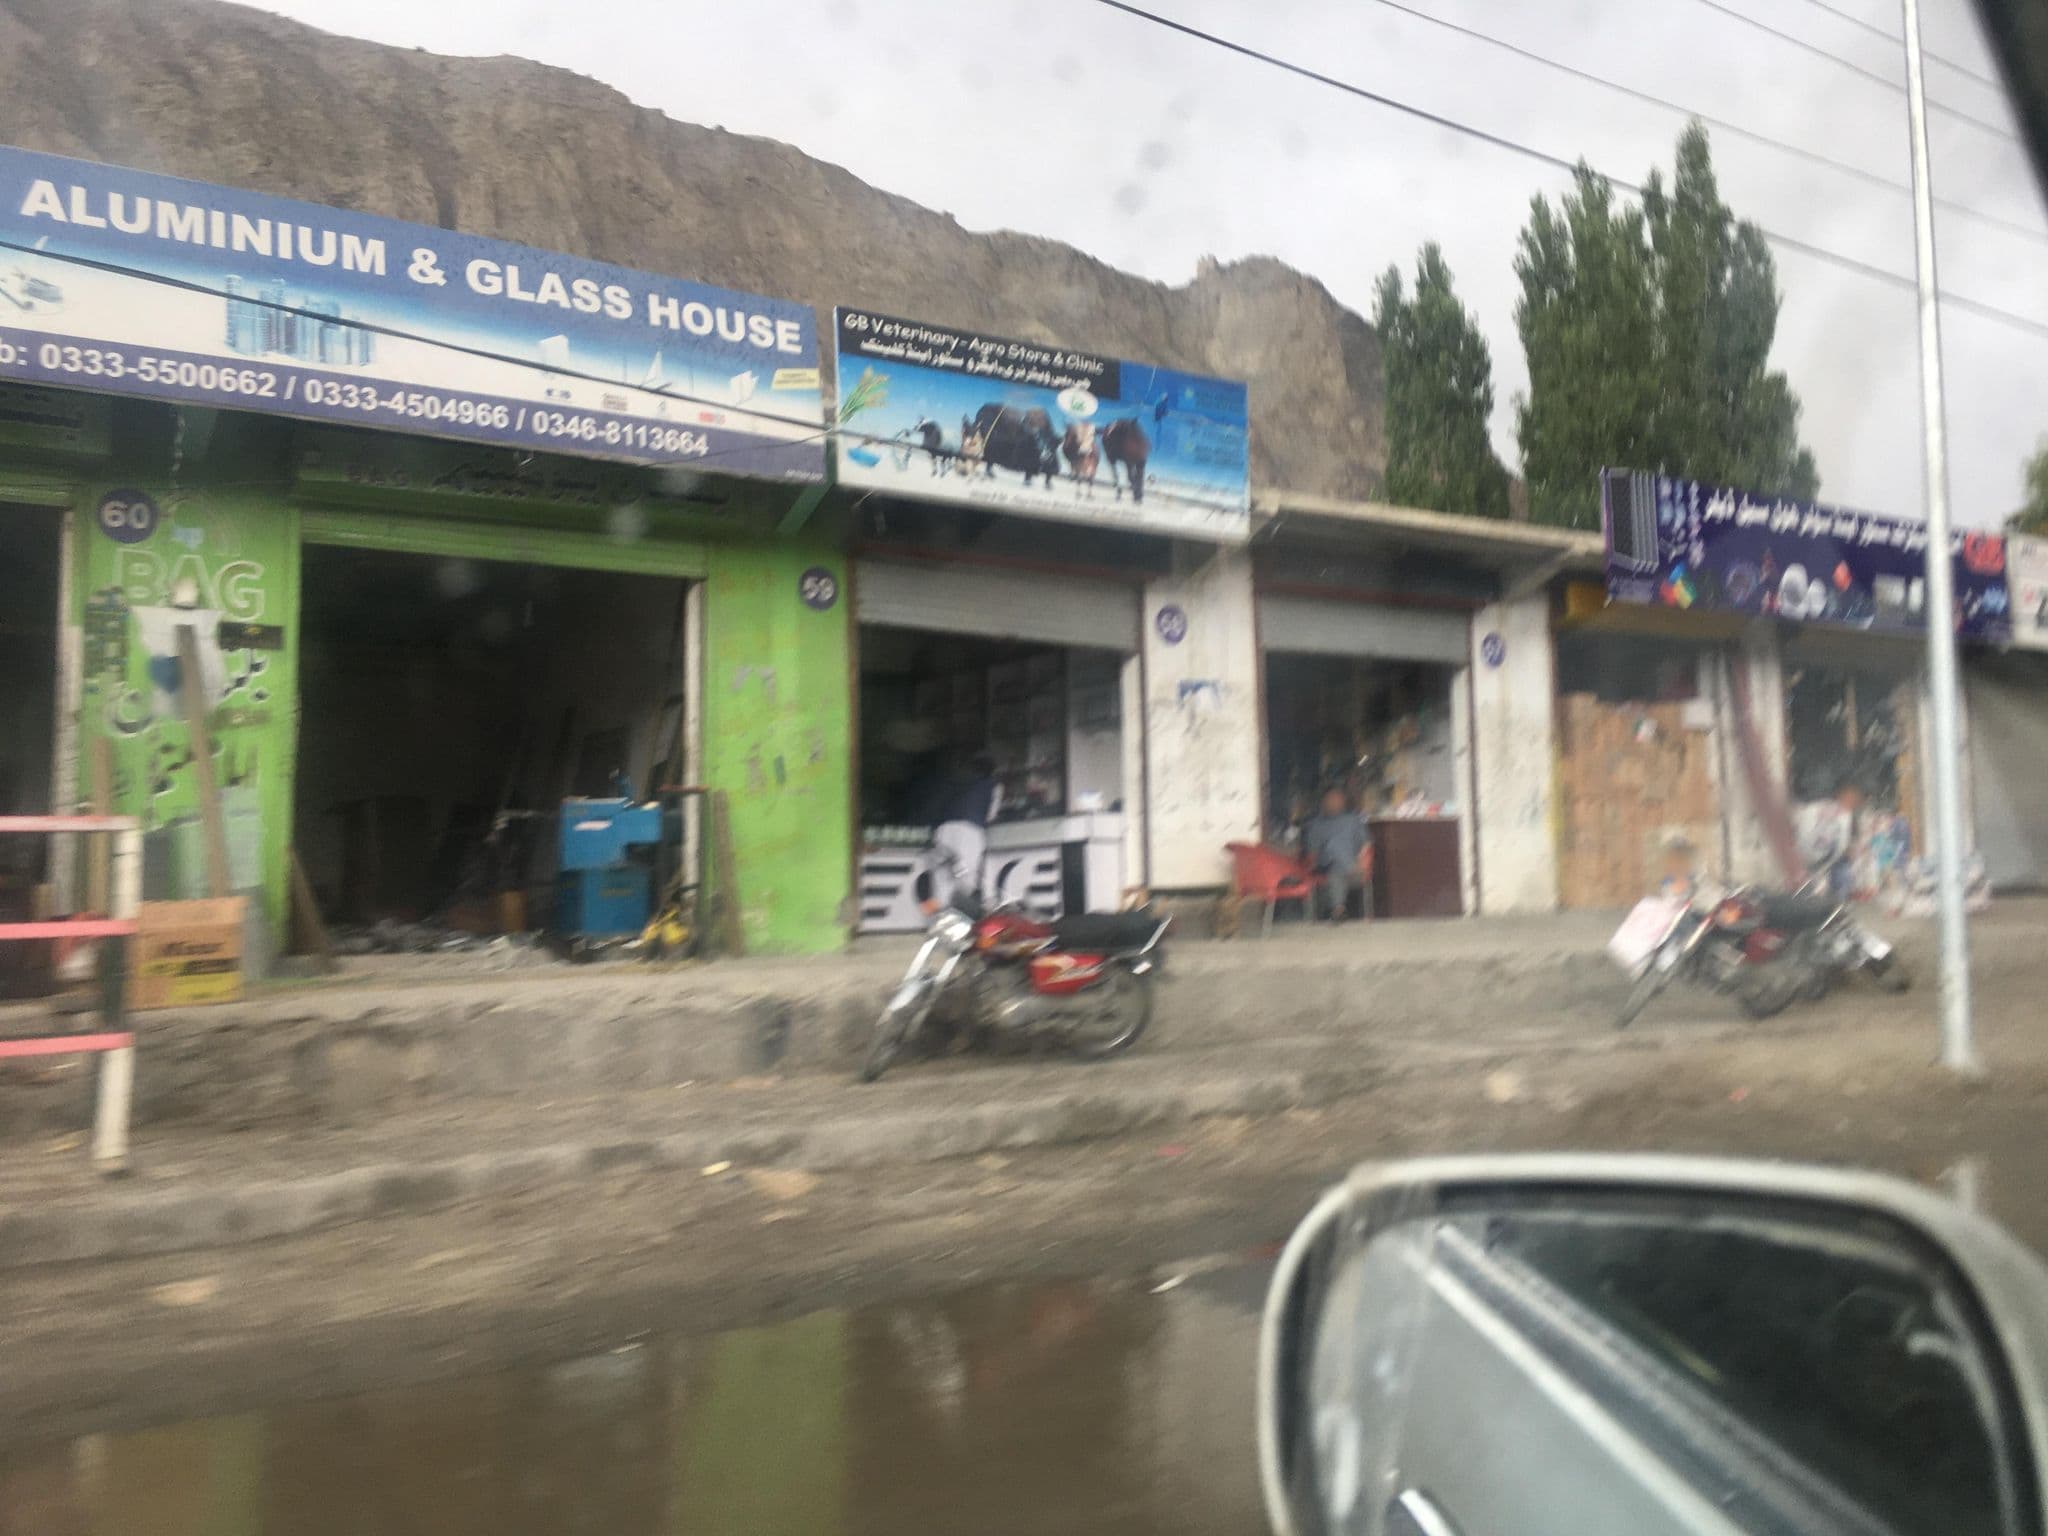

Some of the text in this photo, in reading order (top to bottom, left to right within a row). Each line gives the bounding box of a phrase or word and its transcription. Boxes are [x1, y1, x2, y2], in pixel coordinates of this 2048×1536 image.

[20, 178, 803, 354] ALUMINIUM & GLASS HOUSE
[871, 317, 959, 352] Veterinary
[968, 336, 1006, 359] Agro
[1007, 343, 1052, 364] Store
[1052, 351, 1065, 368] &
[1065, 353, 1105, 376] Clinic
[38, 343, 278, 398] 0333-5500662
[283, 375, 297, 401] /
[304, 379, 509, 430] 0333-4504966
[515, 407, 527, 432] /
[531, 410, 709, 457] 0346-8113664
[101, 500, 150, 529] 60
